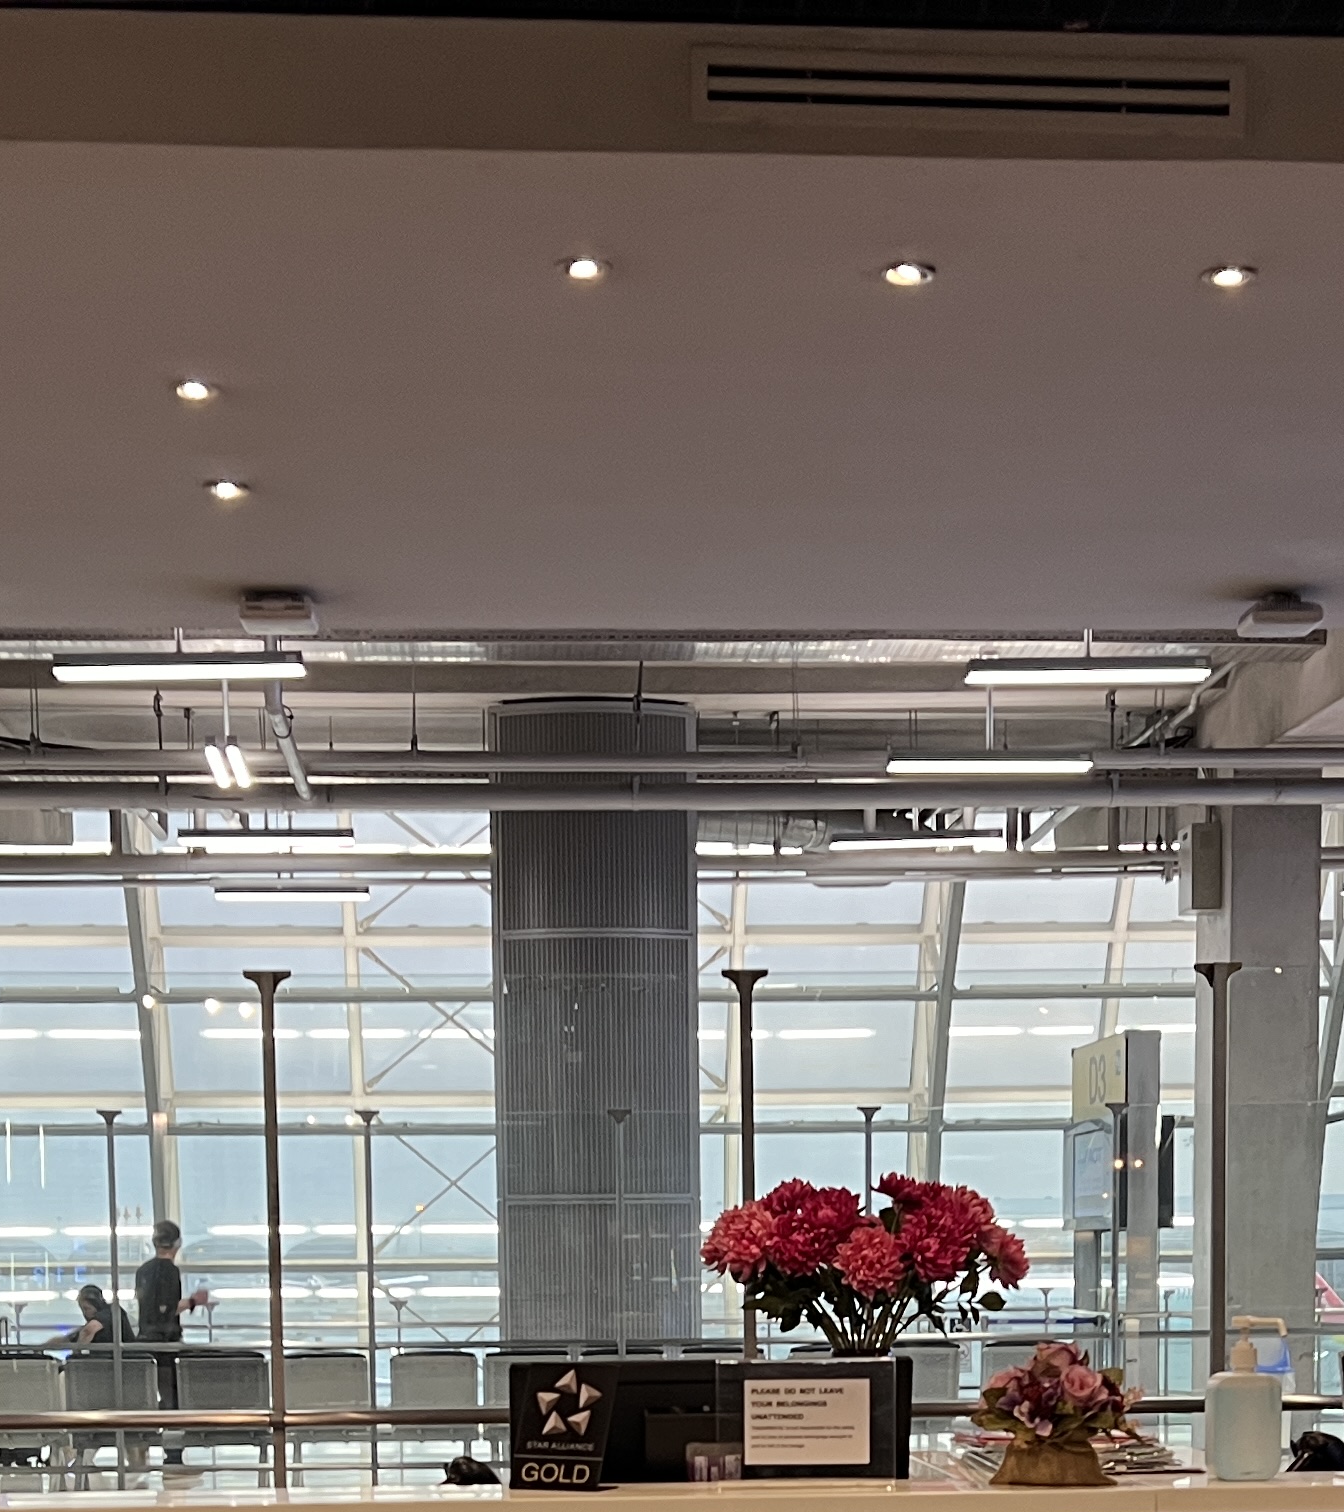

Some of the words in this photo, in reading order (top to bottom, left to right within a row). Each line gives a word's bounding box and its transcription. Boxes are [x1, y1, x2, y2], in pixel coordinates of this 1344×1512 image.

[1089, 1054, 1106, 1105] D3
[526, 1441, 549, 1450] STAR
[550, 1442, 595, 1451] ALLIANCE
[521, 1462, 590, 1484] GOLD
